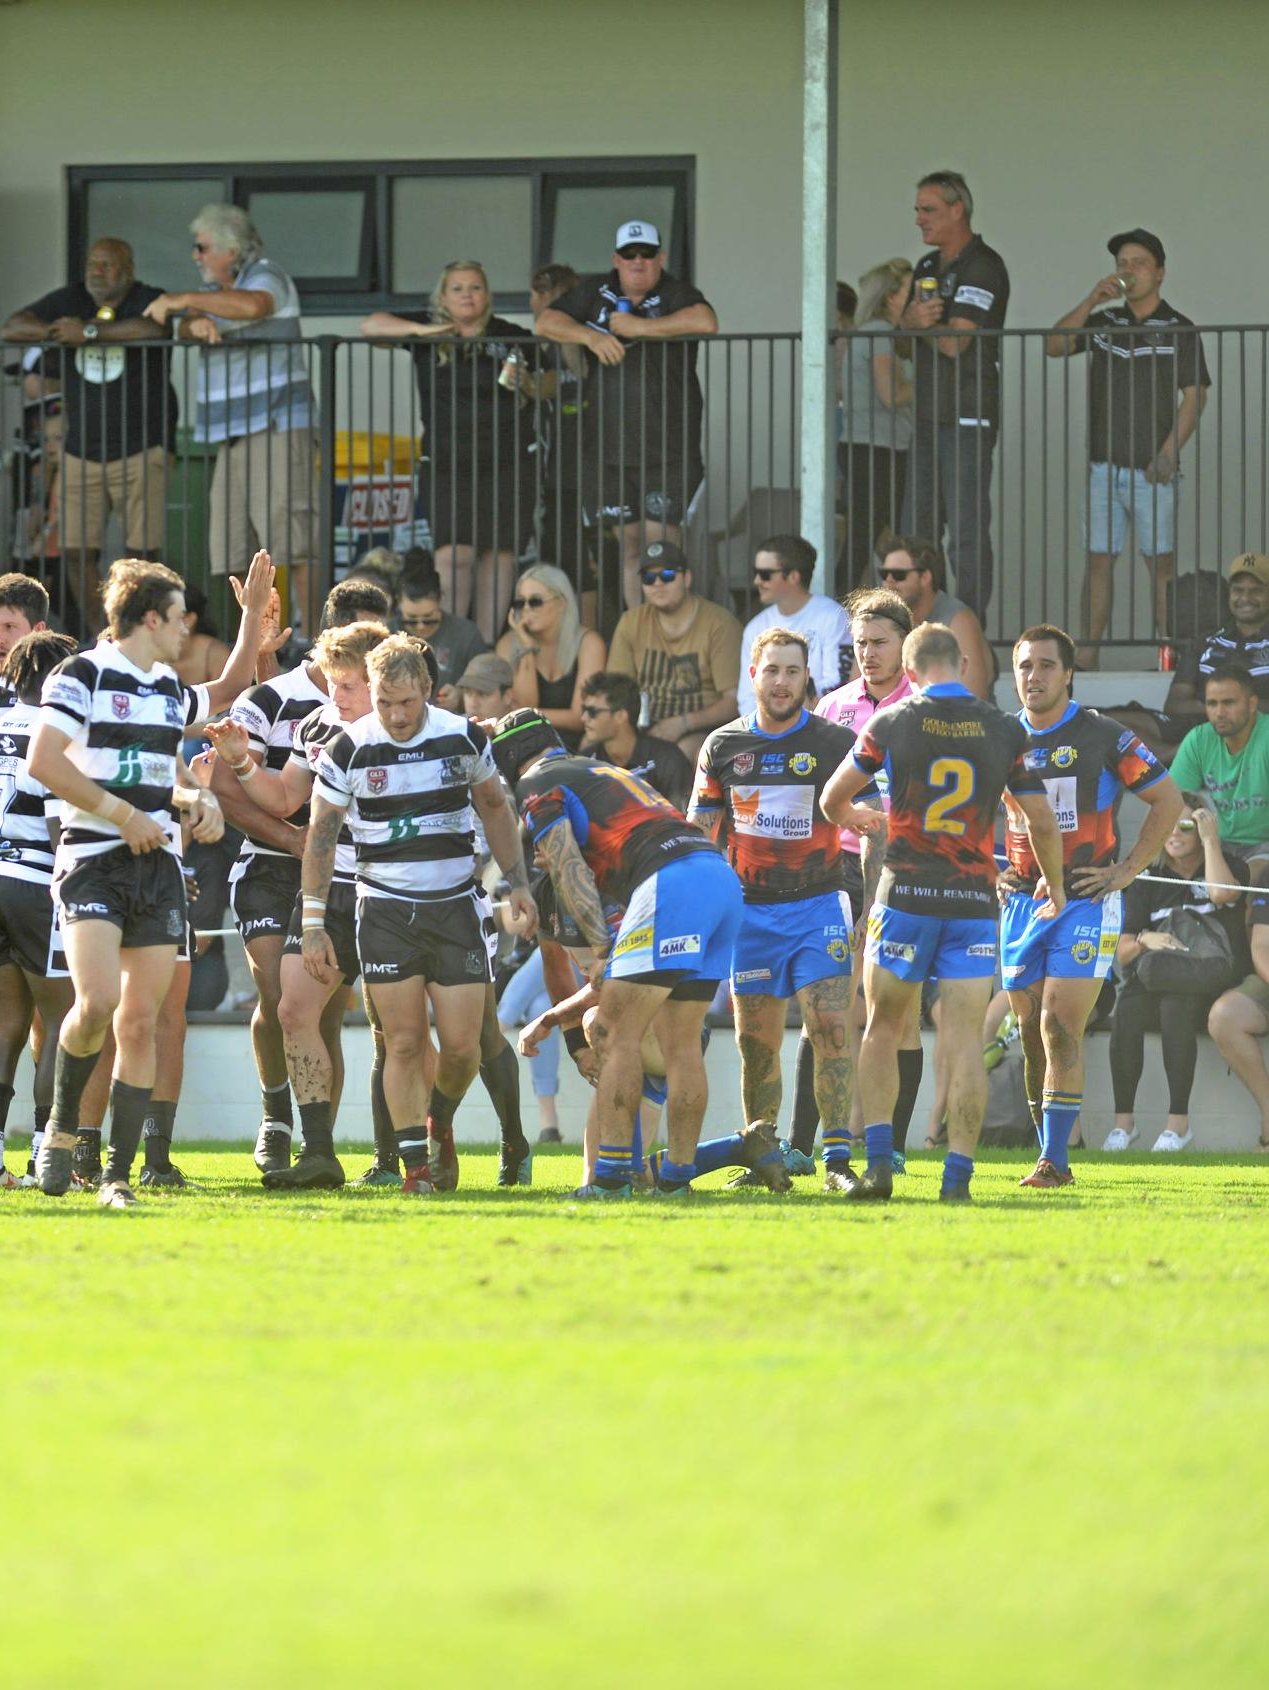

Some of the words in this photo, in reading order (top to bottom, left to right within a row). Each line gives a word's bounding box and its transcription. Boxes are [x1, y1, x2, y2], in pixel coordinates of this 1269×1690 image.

[397, 751, 425, 761] EMU
[760, 753, 786, 763] ISC
[924, 755, 976, 835] 2
[895, 884, 911, 895] WE
[913, 887, 938, 897] WILL
[823, 925, 847, 937] ISC
[1073, 925, 1100, 938] ISC
[660, 943, 687, 956] 4MK
[372, 963, 399, 974] MRC
